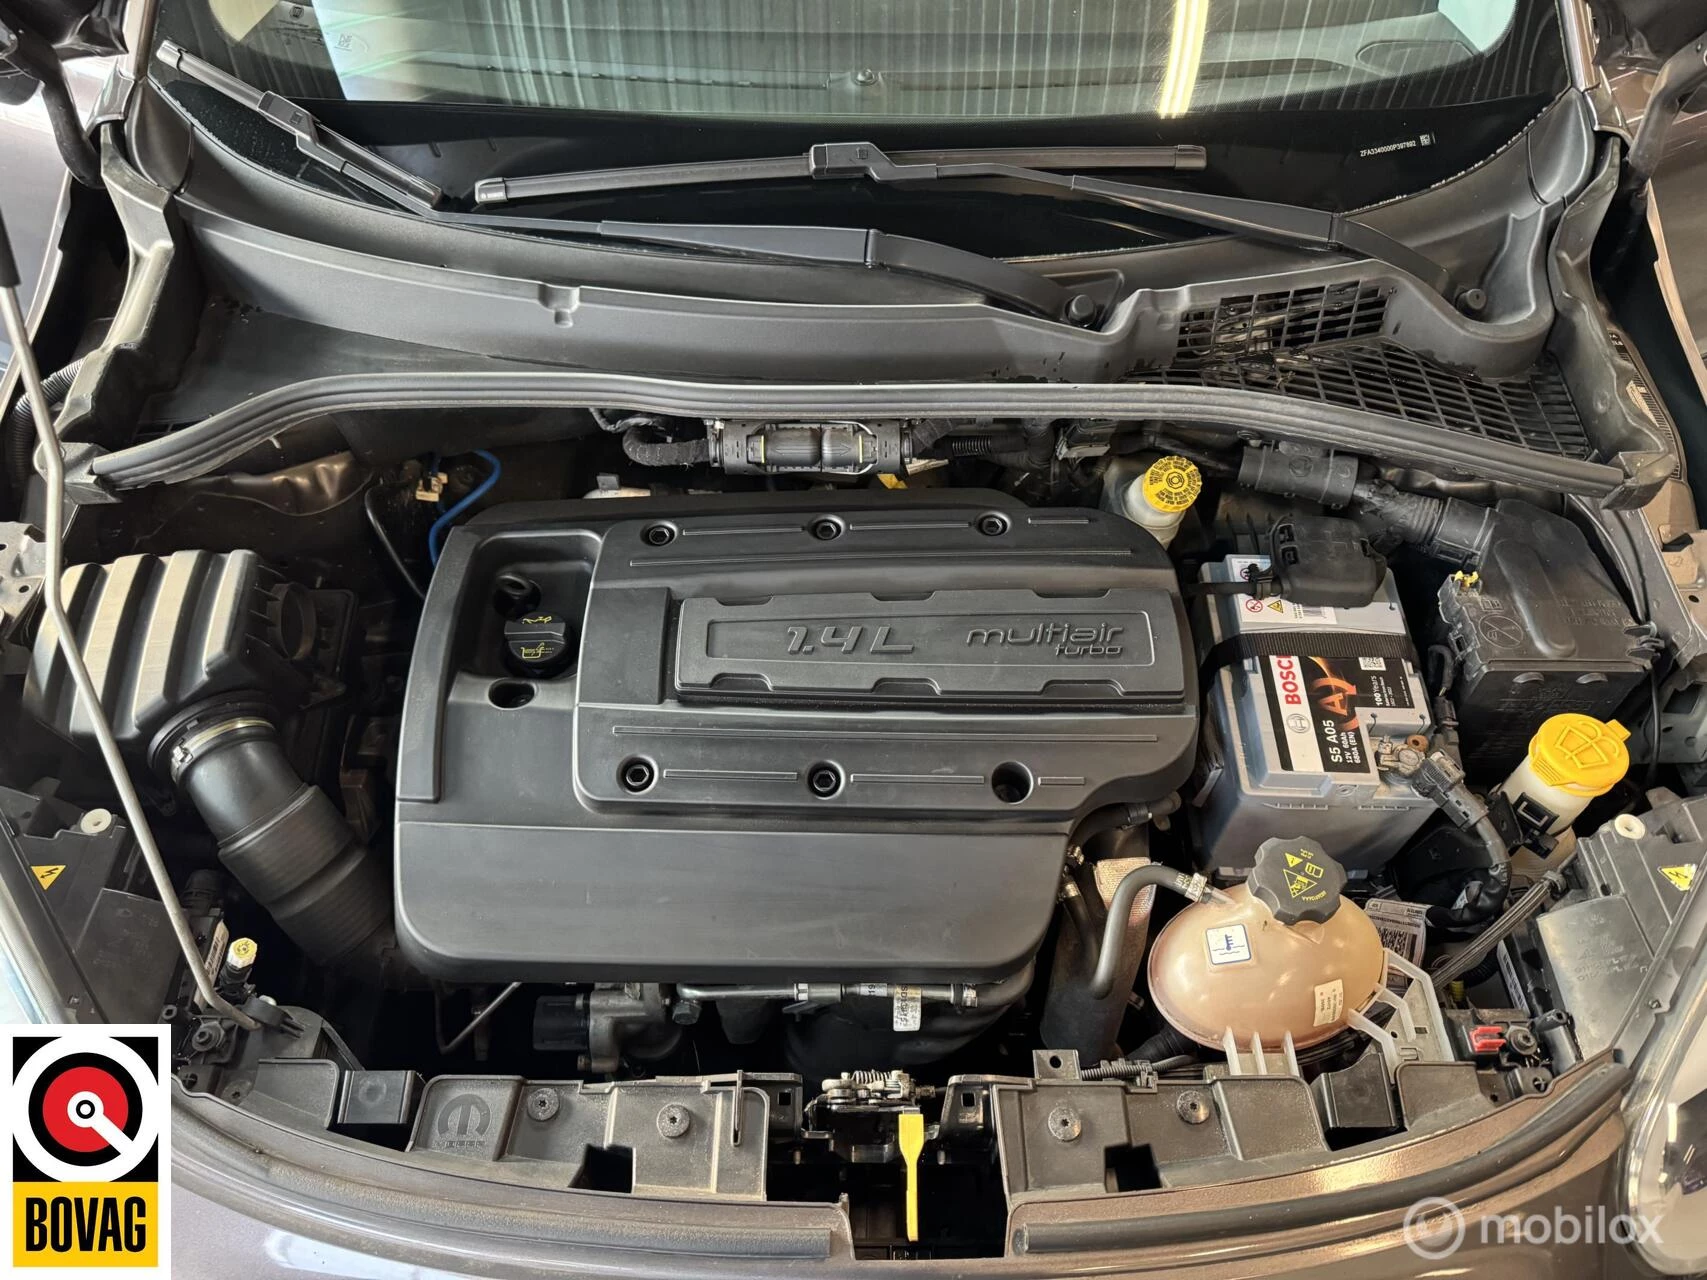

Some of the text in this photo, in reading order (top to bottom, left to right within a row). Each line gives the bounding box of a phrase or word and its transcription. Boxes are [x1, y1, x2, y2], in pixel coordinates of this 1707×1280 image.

[966, 622, 1124, 645] multiair
[1055, 643, 1124, 656] turbo
[1322, 720, 1343, 763] S5 A05
[1344, 751, 1354, 764] 12V
